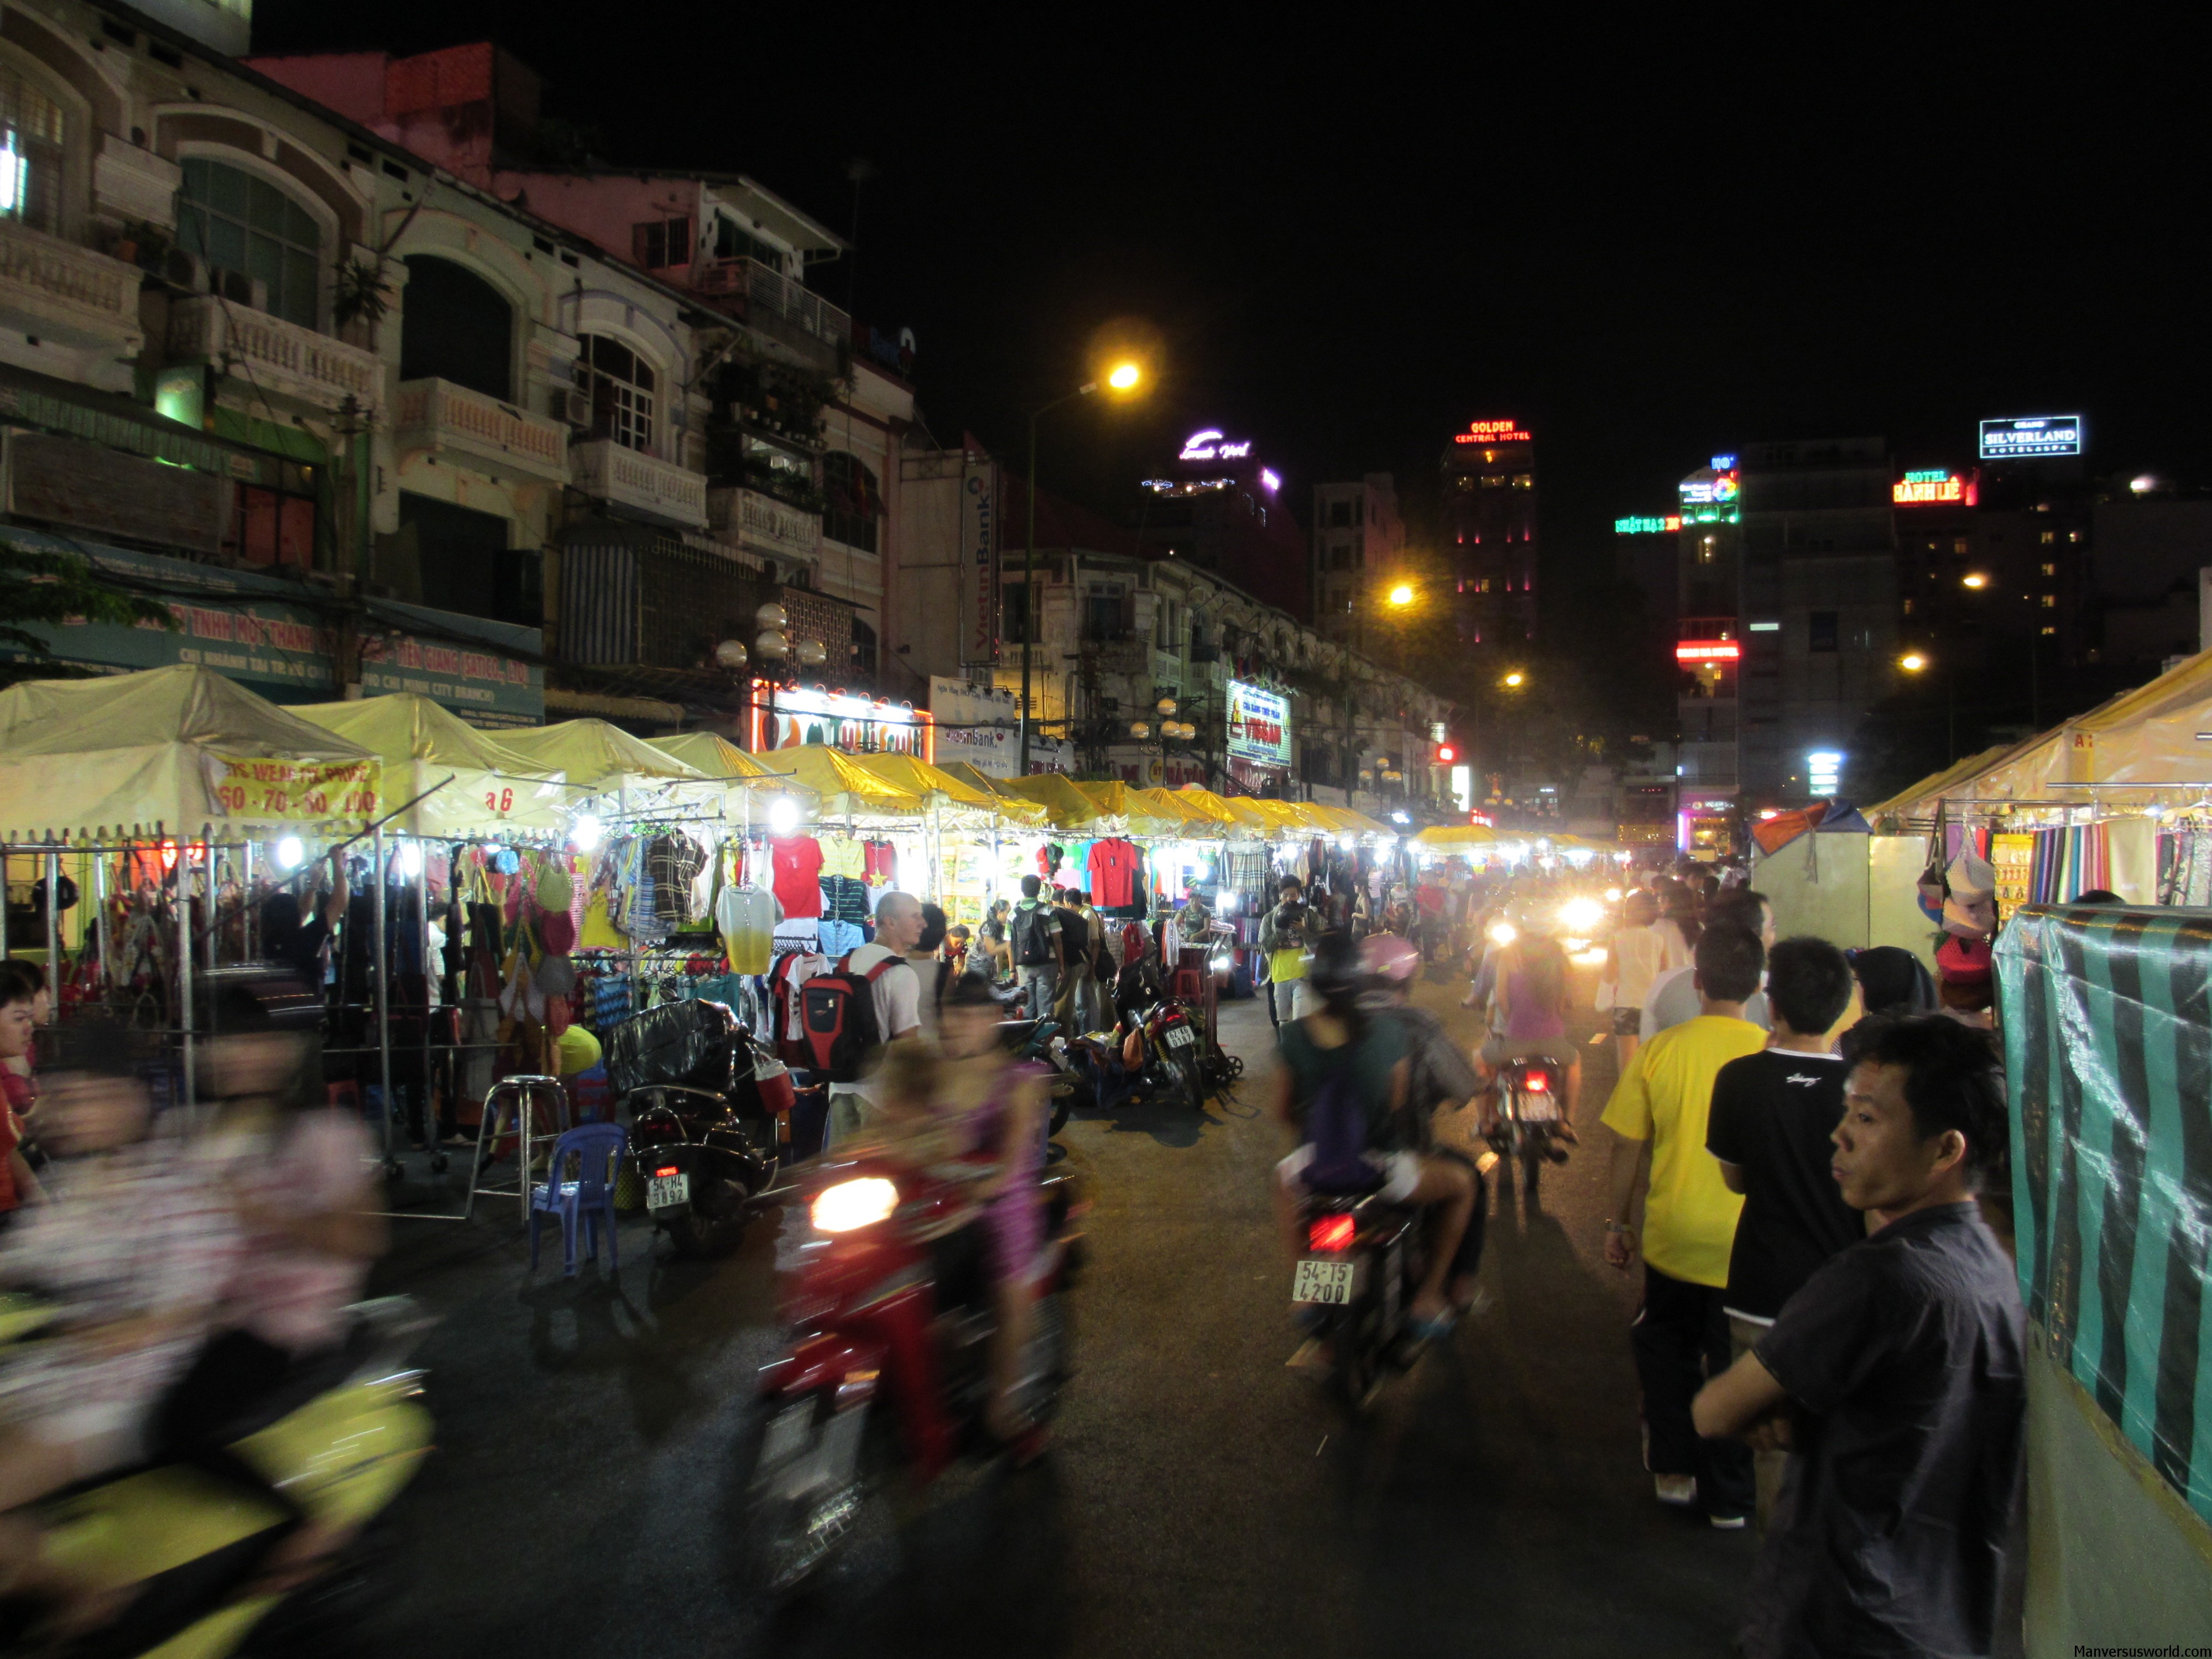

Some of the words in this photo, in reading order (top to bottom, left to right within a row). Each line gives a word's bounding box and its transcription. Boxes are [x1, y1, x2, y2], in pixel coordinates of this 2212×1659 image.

[1470, 421, 1512, 433] GOLDEN
[1455, 434, 1496, 443] CENTRAL
[1499, 432, 1530, 441] HOTEL
[1984, 430, 2076, 445] SILVERLAND
[1905, 471, 1947, 483] HOTEL
[975, 493, 991, 650] VietinBank
[1245, 716, 1282, 744] VISSAN
[263, 790, 288, 813] 70
[1300, 1282, 1339, 1303] 4200
